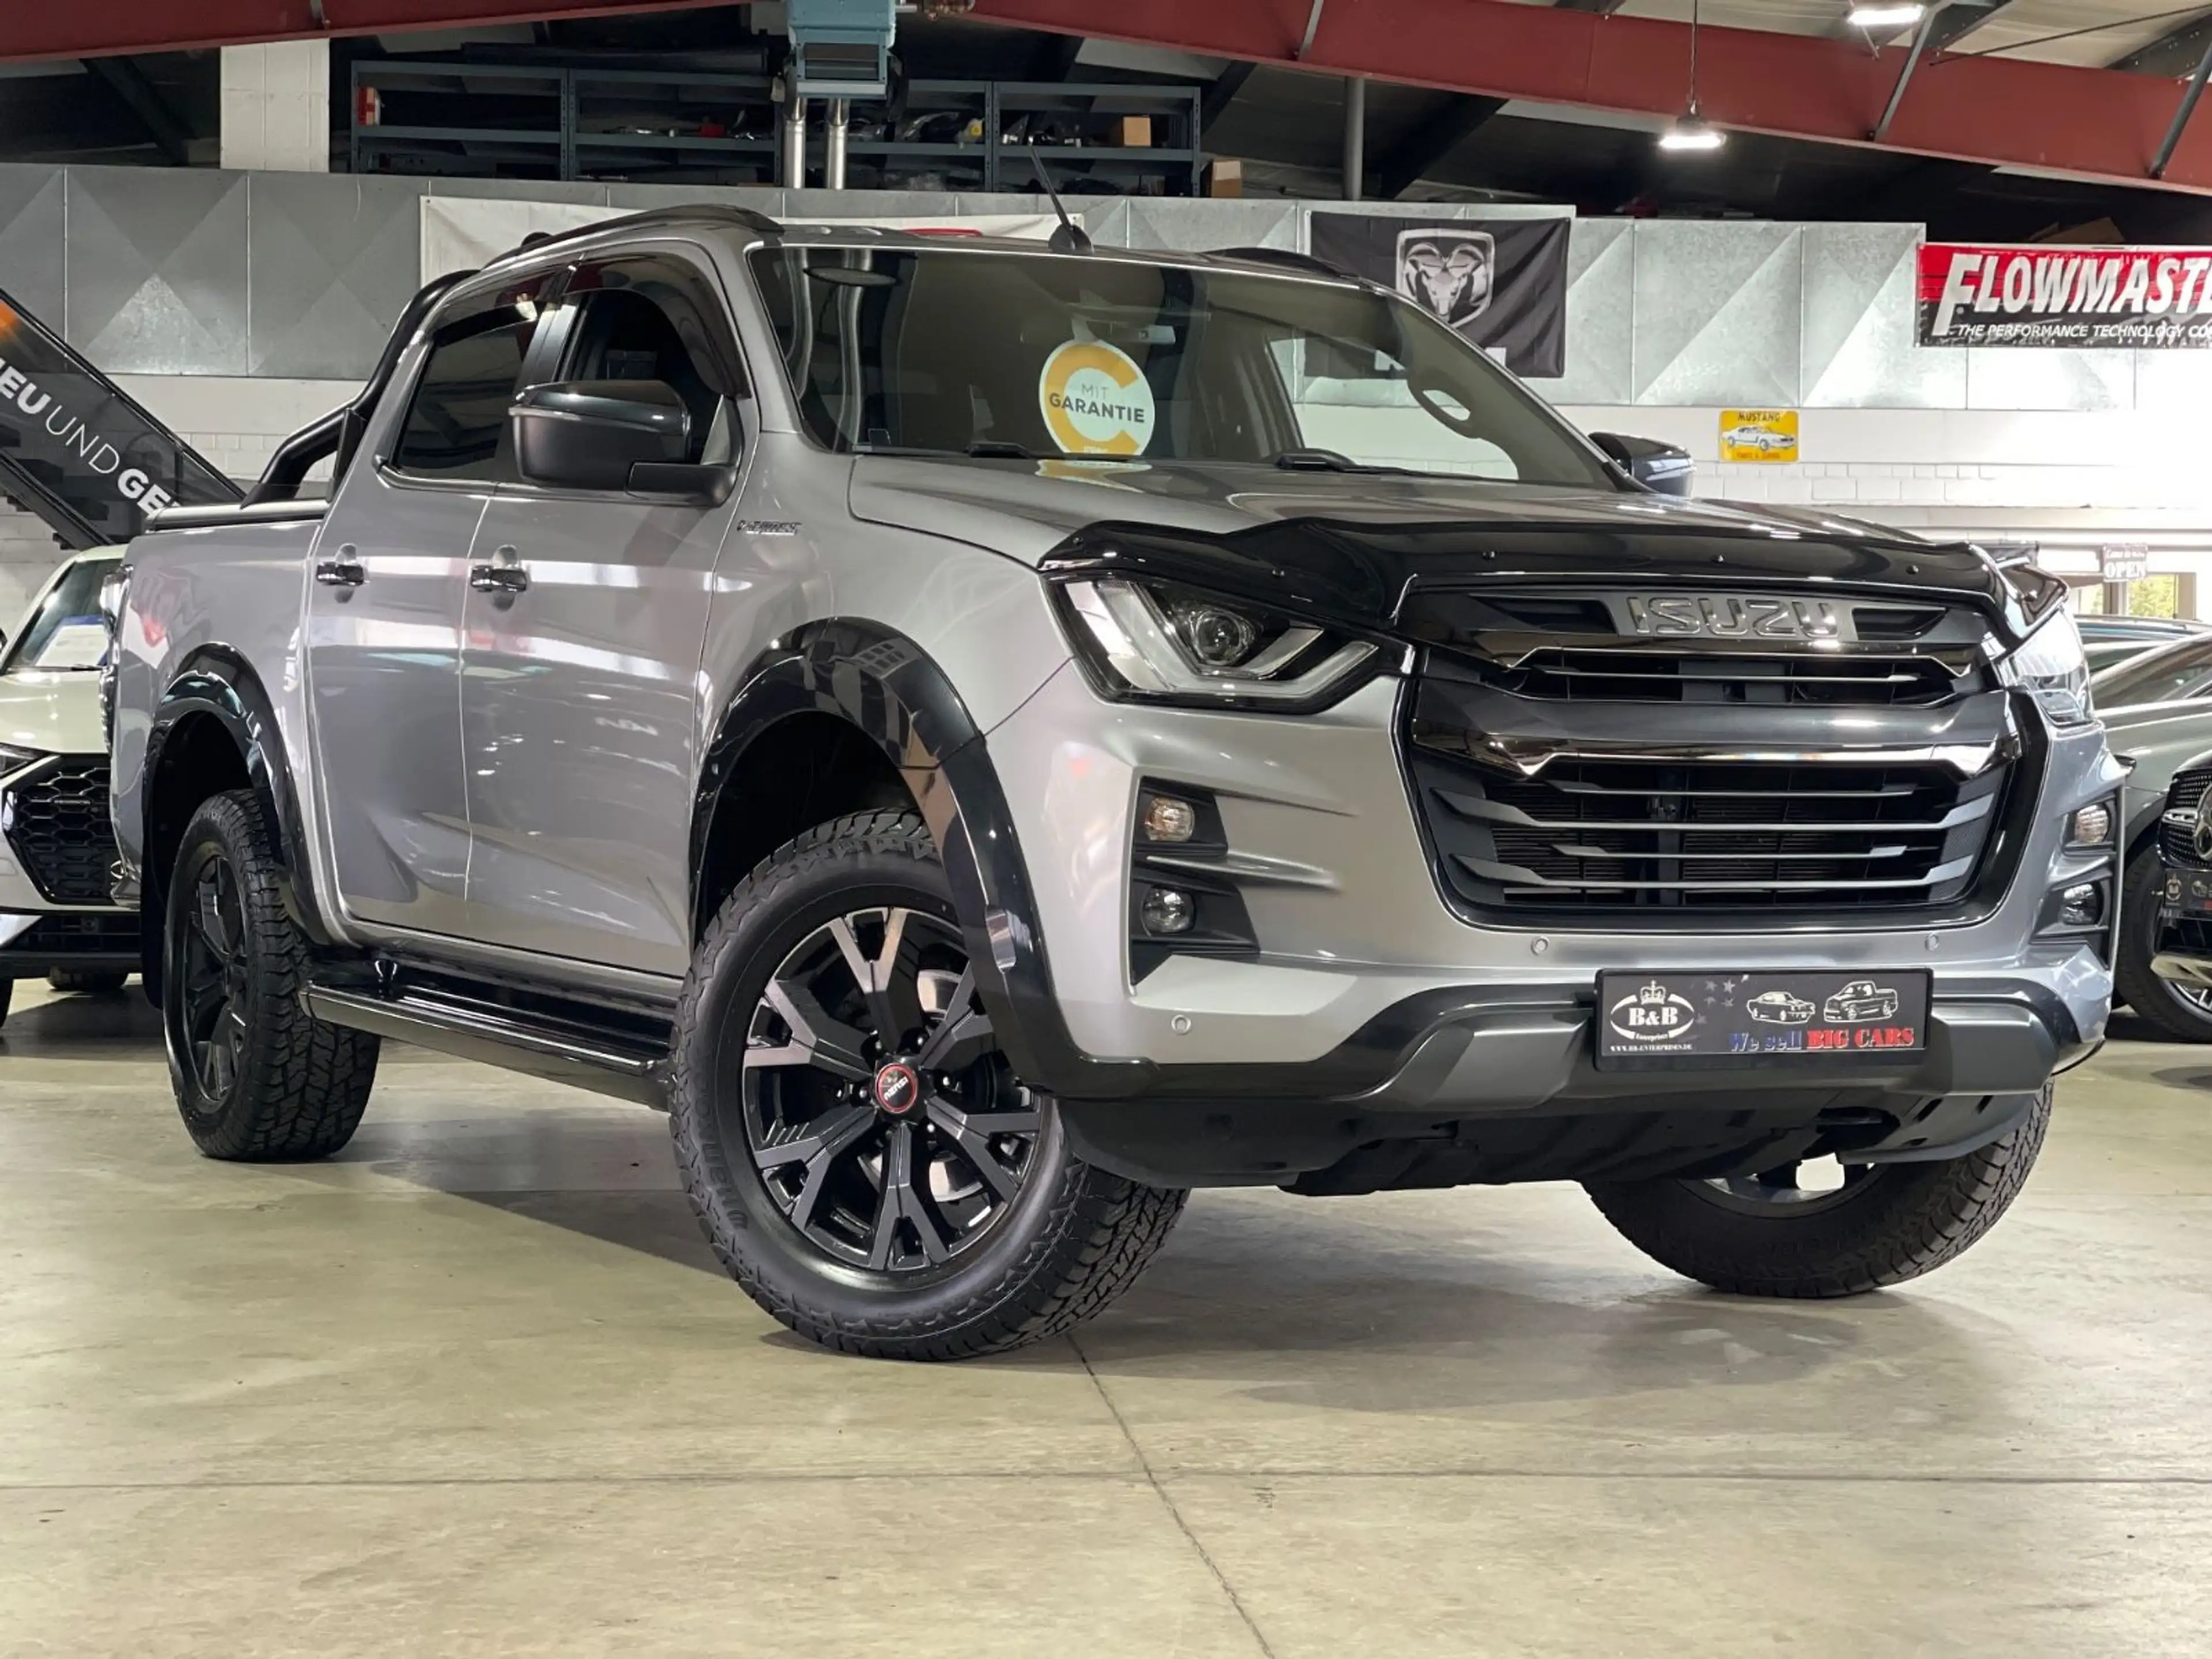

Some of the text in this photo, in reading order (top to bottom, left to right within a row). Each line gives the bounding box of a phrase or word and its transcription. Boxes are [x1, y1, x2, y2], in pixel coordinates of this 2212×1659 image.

[1958, 324, 1985, 336] THE
[1987, 324, 2089, 337] PERFORMANCE
[2092, 324, 2185, 338] TECHNOLOGY
[1082, 382, 1109, 400] MIT
[1048, 392, 1145, 423] GARANTIE
[1626, 596, 1838, 639] ISUZU
[1628, 1007, 1678, 1026] B&B
[1806, 1029, 1849, 1050] BIG
[1854, 1028, 1914, 1048] CARS
